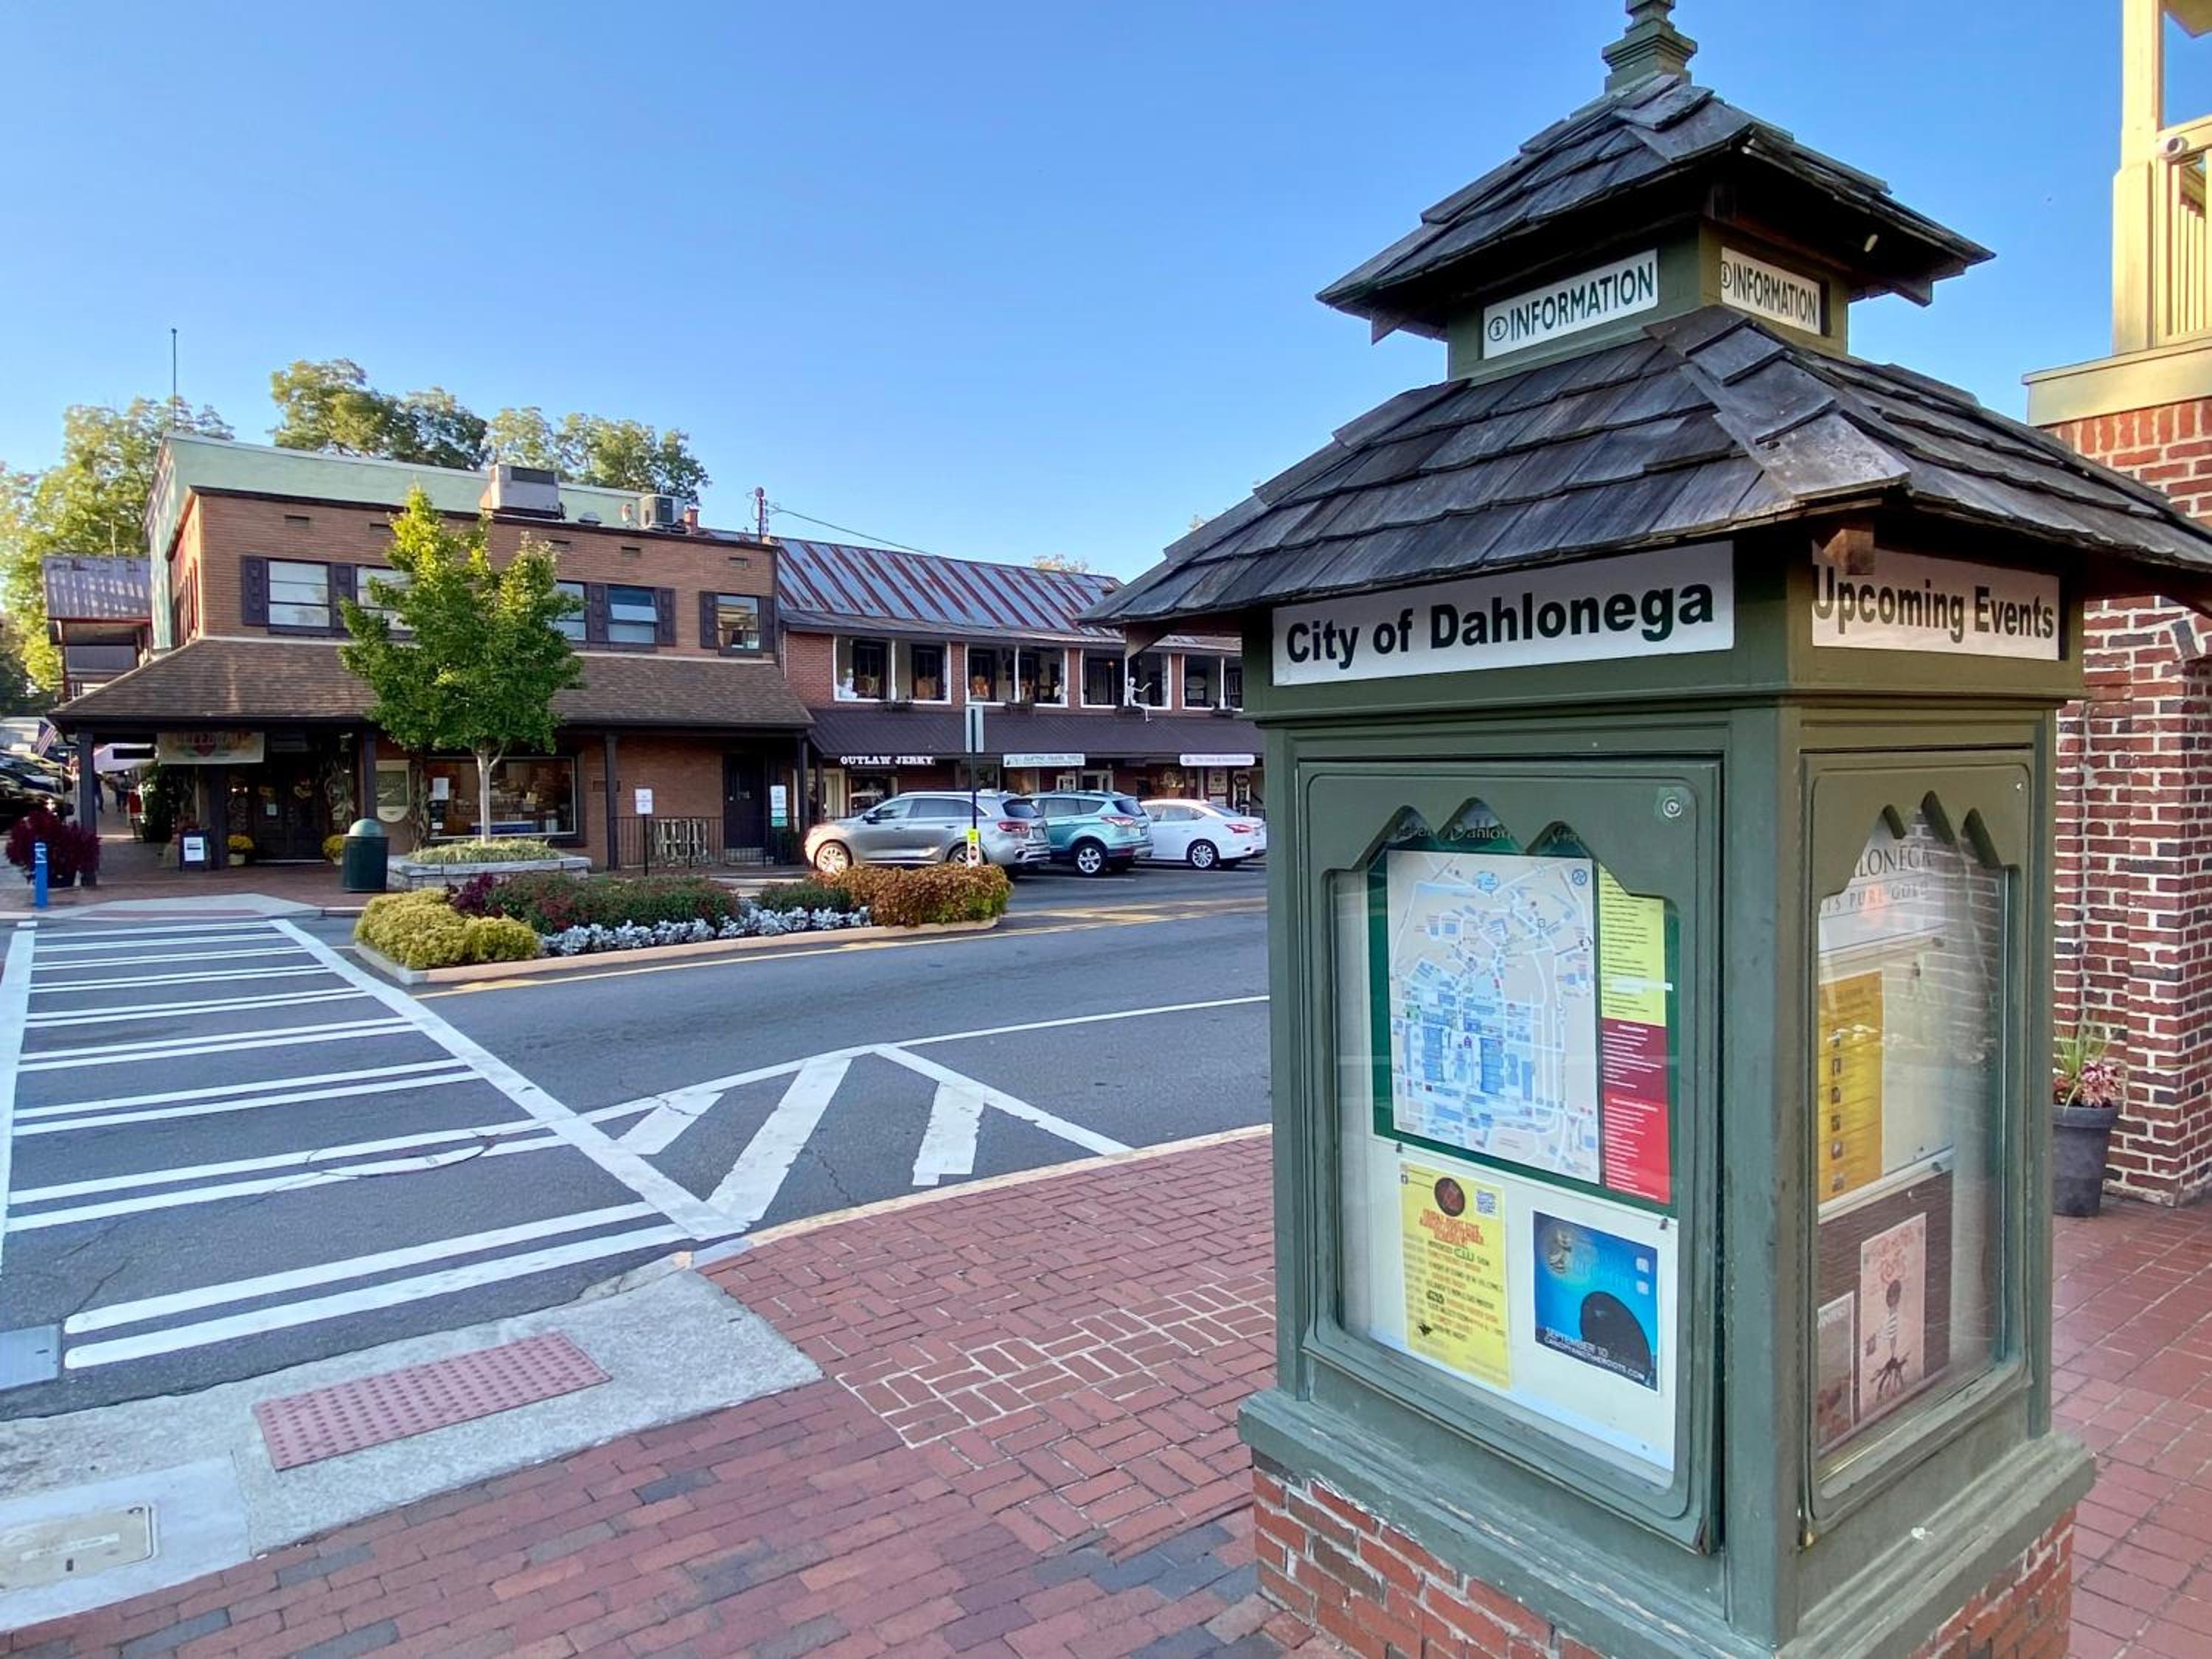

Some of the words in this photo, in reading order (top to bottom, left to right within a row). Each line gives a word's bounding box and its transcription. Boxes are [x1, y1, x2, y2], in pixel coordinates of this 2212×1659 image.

[1509, 262, 1655, 342] INFORMATION
[1733, 262, 1818, 327] INFORMATION
[1286, 619, 1359, 670] City
[1373, 609, 1413, 655] of
[1430, 582, 1714, 649] Dahlonega
[1813, 563, 1965, 643] Upcoming
[1974, 585, 2054, 640] Events
[840, 756, 891, 765] OUTLAW
[895, 756, 933, 765] JERKY
